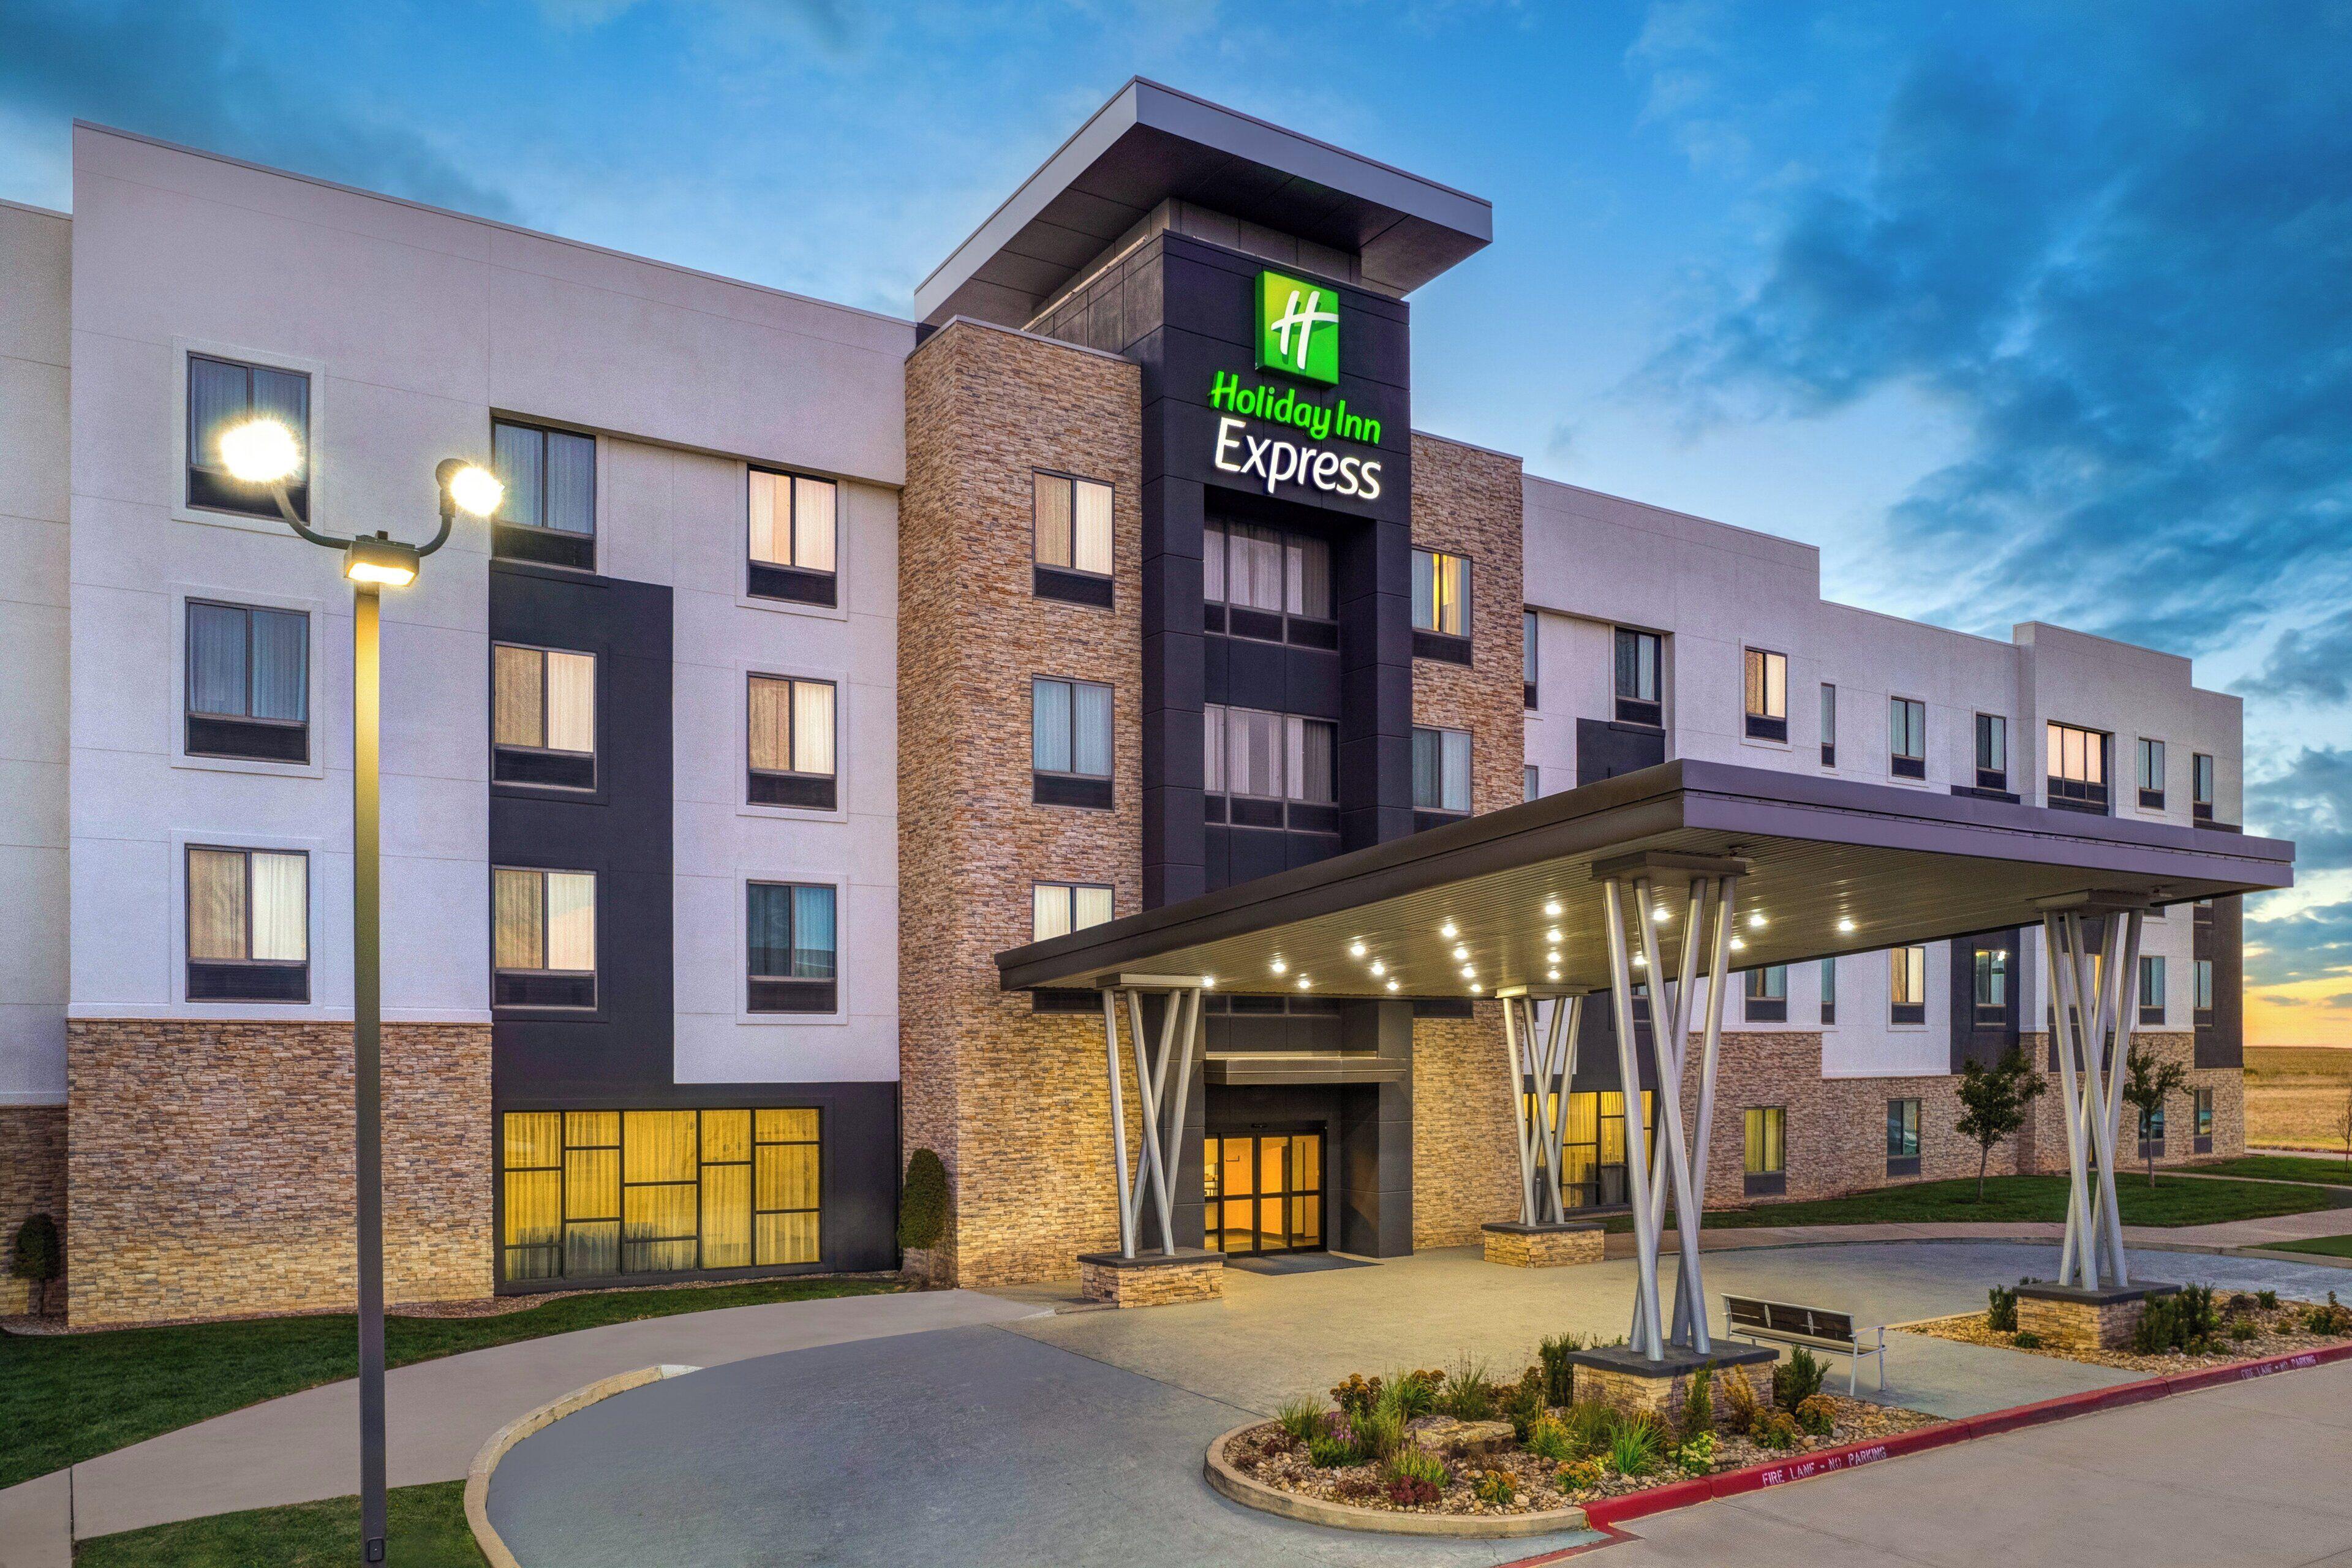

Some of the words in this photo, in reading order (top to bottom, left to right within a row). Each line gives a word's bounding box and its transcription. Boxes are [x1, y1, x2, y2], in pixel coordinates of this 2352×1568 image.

[1270, 290, 1339, 369] H
[1209, 371, 1331, 440] Holiday
[1336, 399, 1381, 444] Inn
[1215, 417, 1382, 499] Express
[2291, 1354, 2316, 1369] PARKING
[1762, 1469, 1785, 1487] FIRE
[1828, 1457, 1842, 1471] NO
[1848, 1446, 1887, 1466] PARKING
